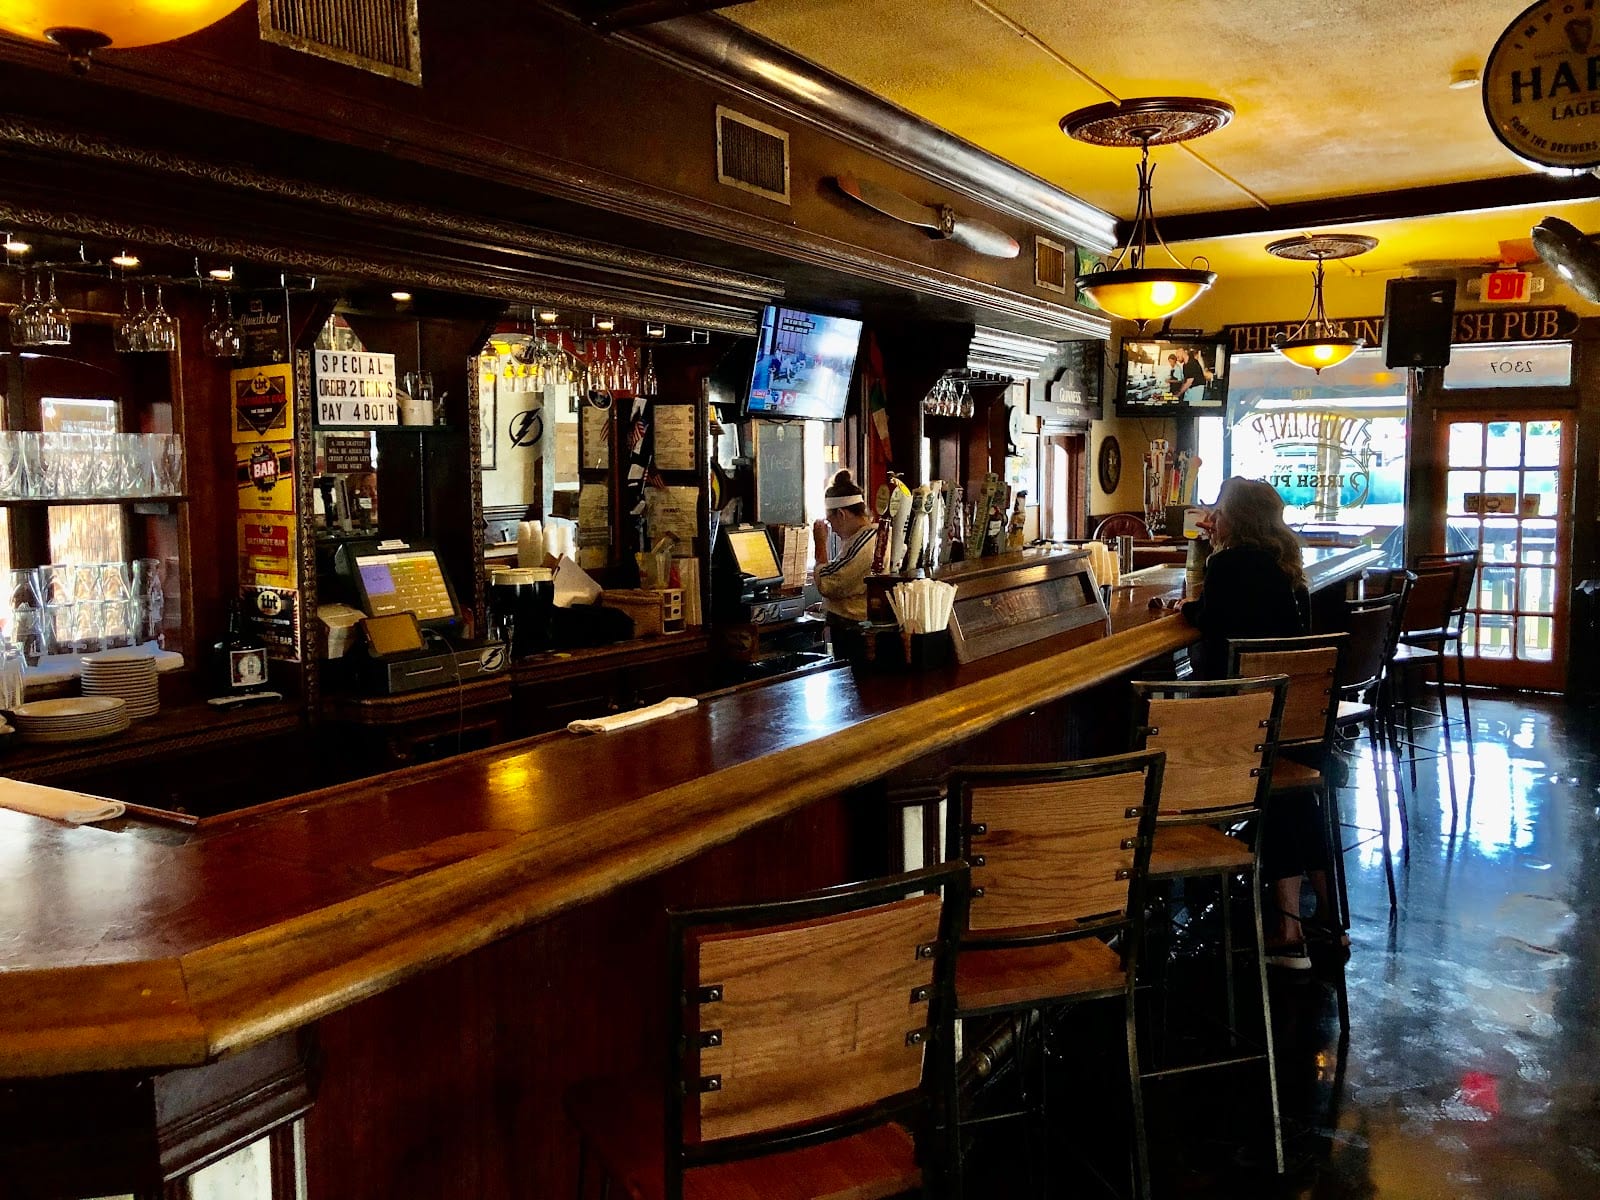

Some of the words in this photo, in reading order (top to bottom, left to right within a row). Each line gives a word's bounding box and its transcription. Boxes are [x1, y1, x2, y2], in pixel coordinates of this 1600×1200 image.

[1530, 134, 1548, 149] THE
[1550, 141, 1599, 154] BREWERS
[1487, 273, 1526, 300] EXIT
[1230, 325, 1278, 352] THE
[1502, 310, 1559, 340] PUB
[321, 354, 383, 375] SPECIAL
[320, 379, 347, 397] ORDER
[350, 380, 357, 397] 2
[321, 402, 342, 421] PAY
[353, 403, 361, 421] 4
[364, 403, 395, 421] BOTH
[253, 460, 275, 478] BAR
[261, 594, 278, 610] tbt
